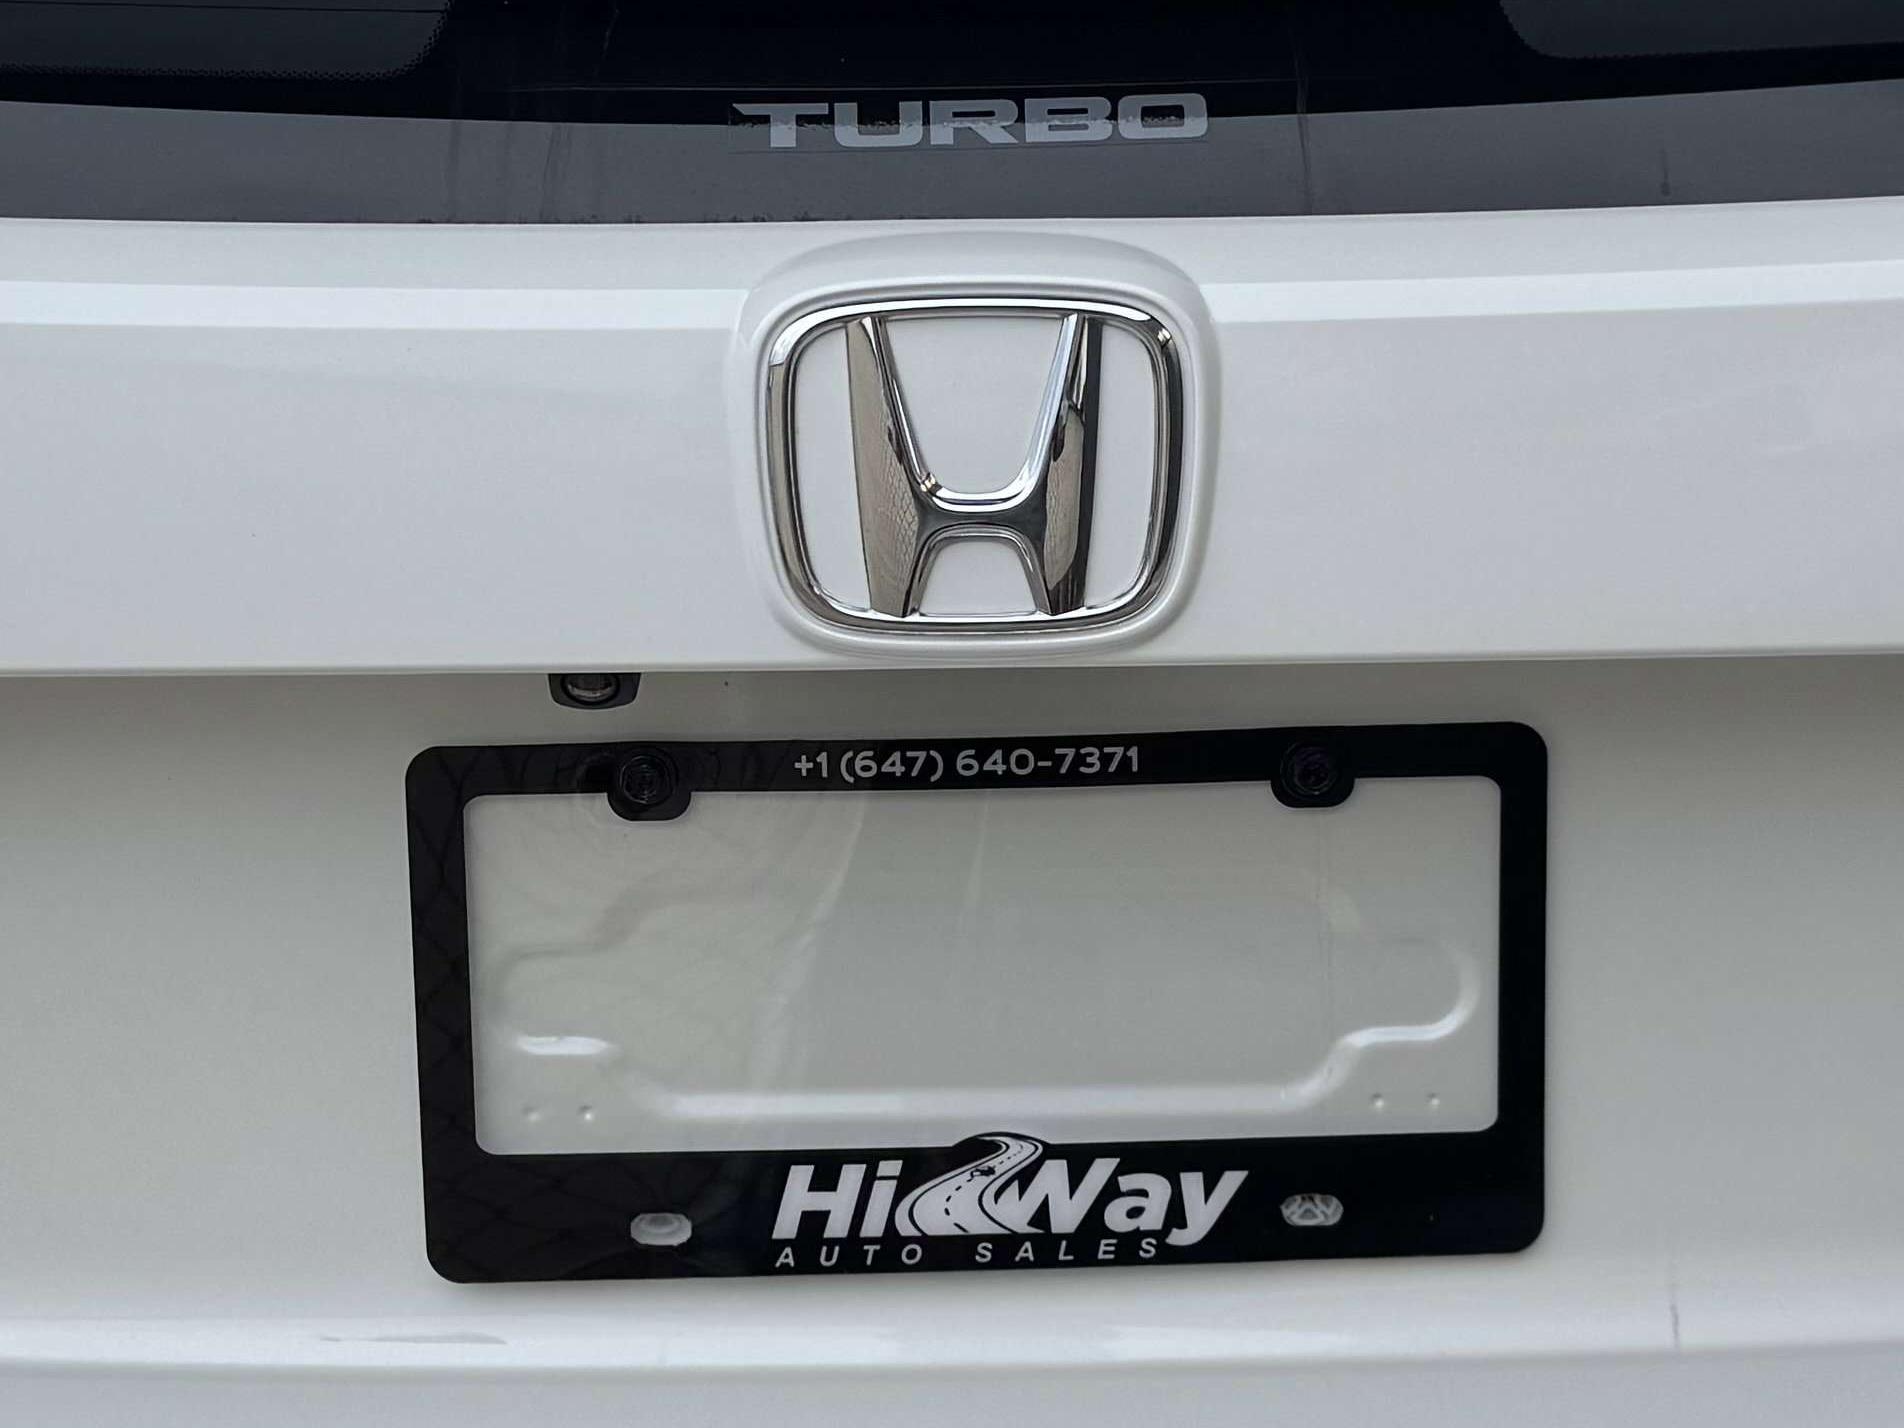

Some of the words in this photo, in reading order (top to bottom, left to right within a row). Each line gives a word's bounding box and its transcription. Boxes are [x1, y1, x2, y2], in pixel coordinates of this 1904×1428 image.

[731, 92, 1209, 149] TURBO
[794, 751, 829, 778] +1
[839, 749, 944, 784] (647)
[955, 745, 1140, 777] 640-7371
[775, 1241, 923, 1268] AUTO
[975, 1237, 1158, 1263] SALES
